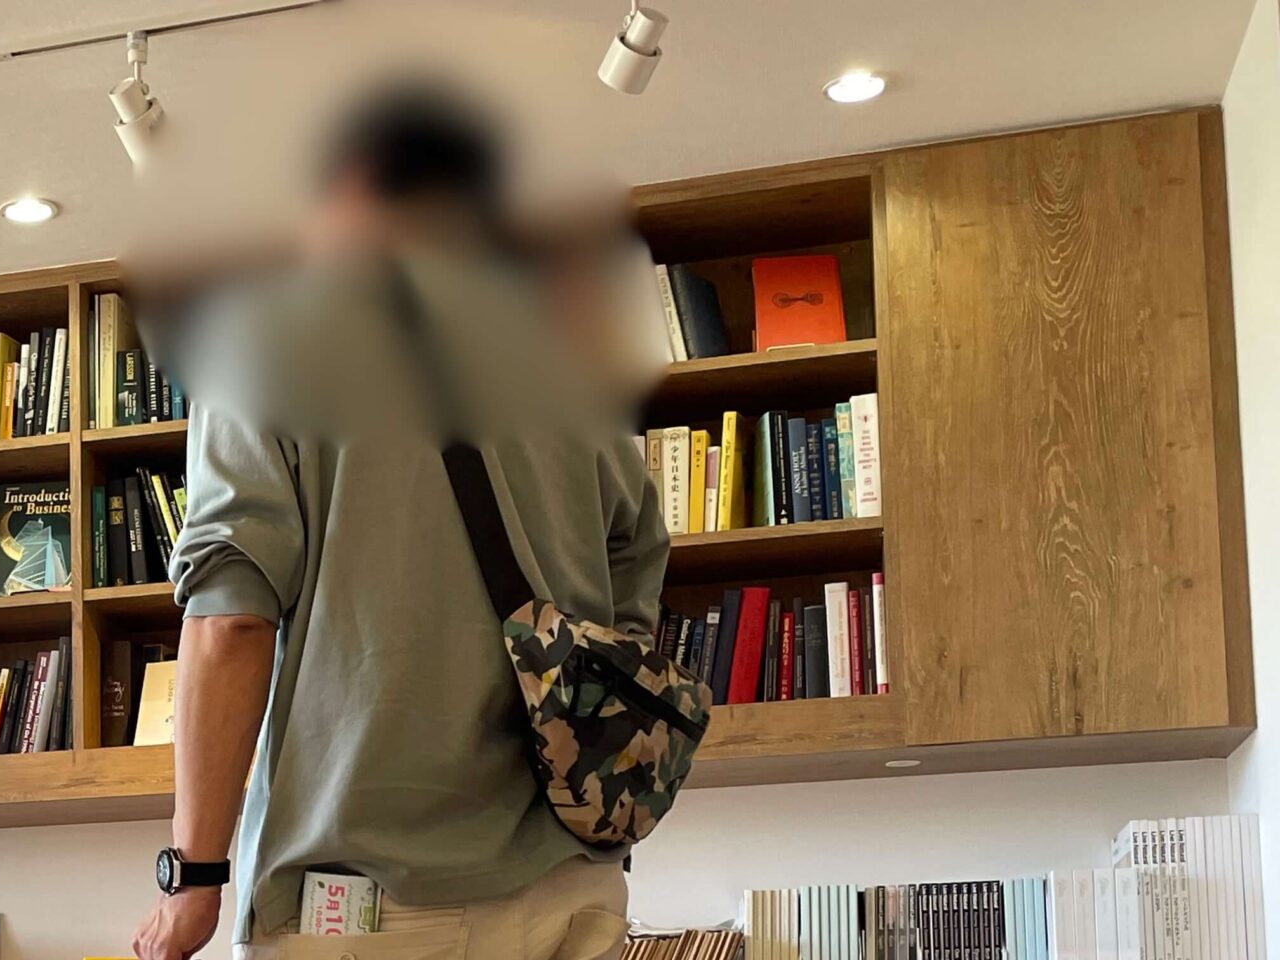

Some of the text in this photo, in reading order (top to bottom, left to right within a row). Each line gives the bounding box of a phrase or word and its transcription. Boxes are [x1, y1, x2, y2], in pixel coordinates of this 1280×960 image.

[670, 444, 680, 493] 少年日本史
[4, 488, 71, 504] Introducti
[25, 502, 71, 515] Busines
